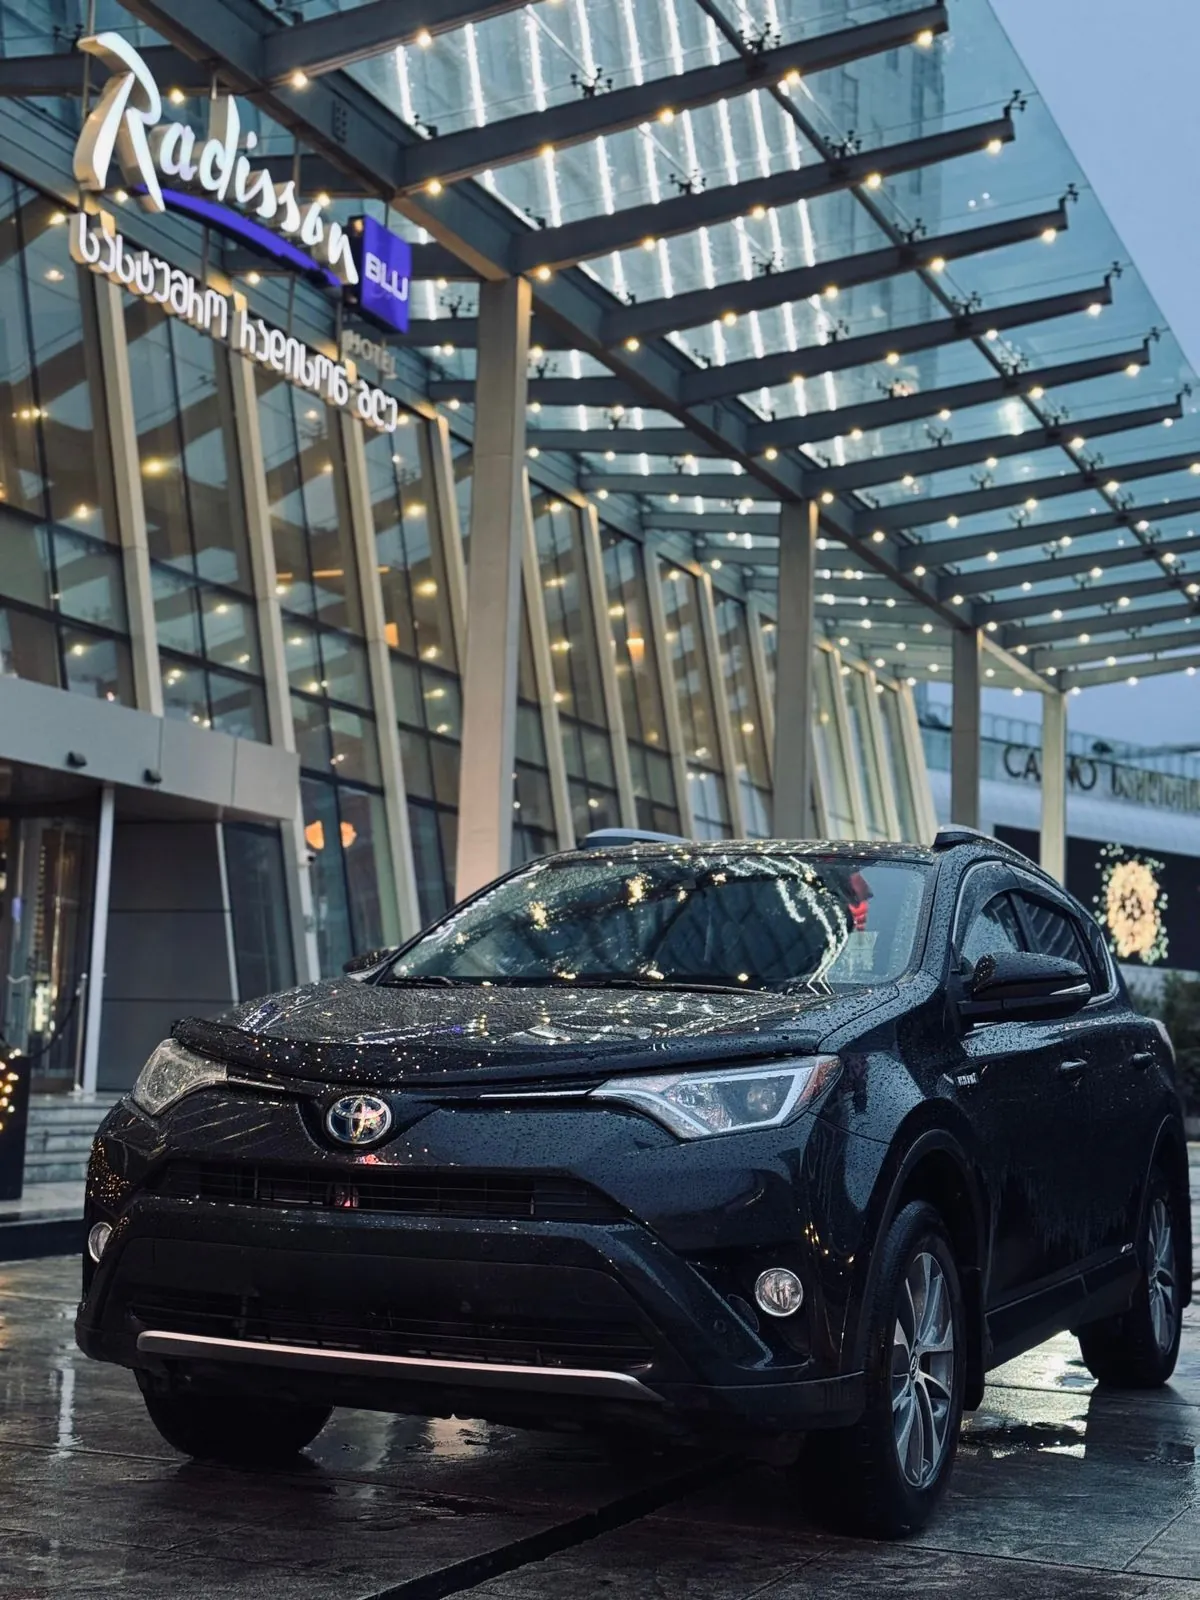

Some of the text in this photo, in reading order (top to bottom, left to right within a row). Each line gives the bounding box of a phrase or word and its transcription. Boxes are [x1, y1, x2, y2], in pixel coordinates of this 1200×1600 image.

[88, 32, 408, 301] Radisson BLU
[79, 212, 398, 432] სასტუმრო რადისონ ბლუ
[343, 330, 397, 379] HOTEL
